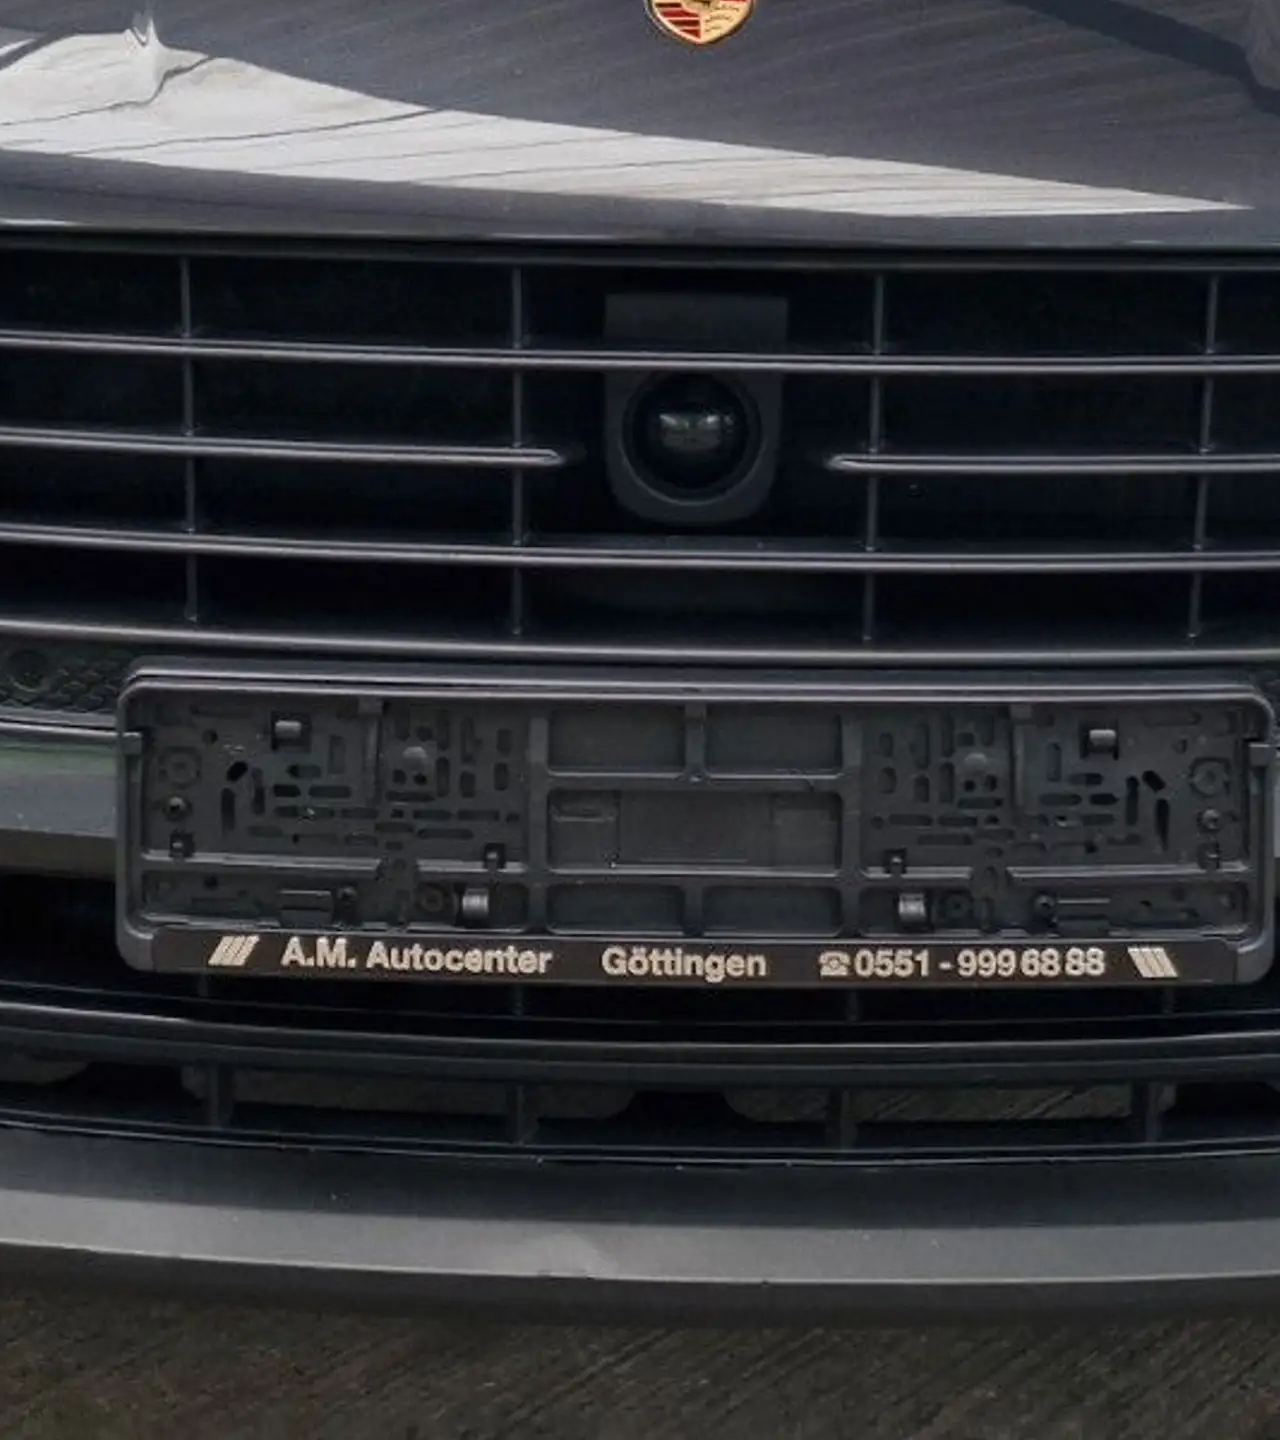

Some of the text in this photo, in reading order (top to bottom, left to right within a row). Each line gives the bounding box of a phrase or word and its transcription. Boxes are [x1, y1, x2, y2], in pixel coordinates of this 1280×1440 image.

[280, 935, 357, 969] A.M.
[366, 940, 553, 974] Autocenter
[601, 945, 767, 983] Göttingen
